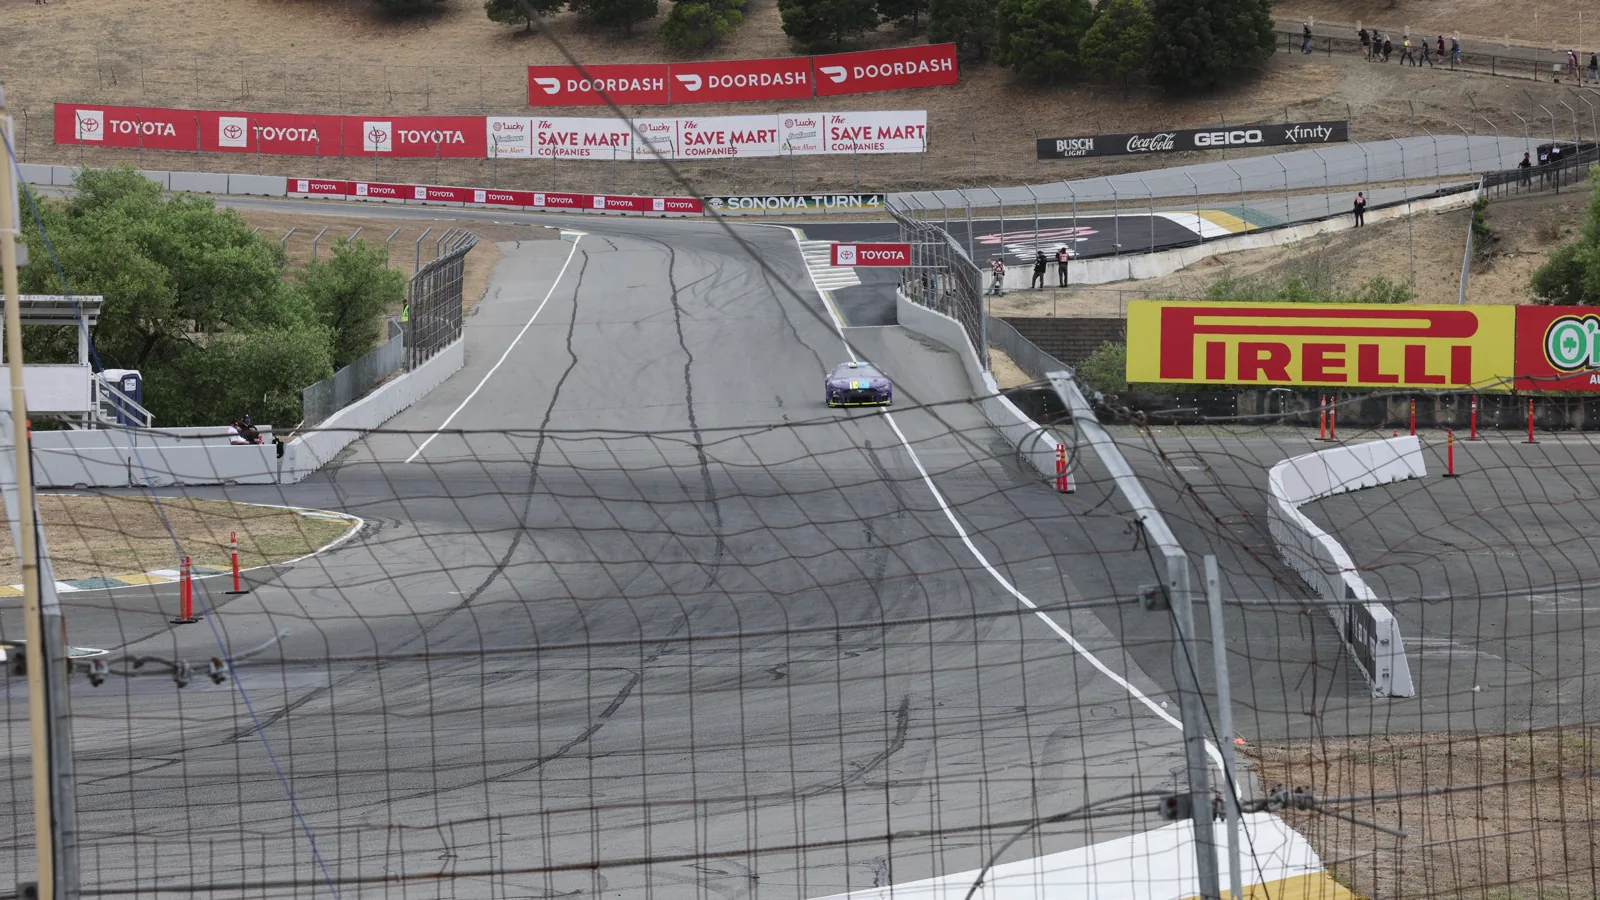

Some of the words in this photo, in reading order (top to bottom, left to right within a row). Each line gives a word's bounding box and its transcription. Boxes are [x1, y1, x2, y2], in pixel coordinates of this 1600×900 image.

[854, 58, 952, 79] DOORDASH
[567, 78, 664, 92] DOORDASH
[708, 72, 806, 88] DOORDASH
[538, 120, 552, 129] The
[684, 120, 698, 129] The
[794, 118, 816, 128] Lucky
[830, 115, 846, 124] The
[110, 120, 176, 136] TOYOTA
[253, 126, 320, 142] TOYOTA
[503, 122, 524, 132] Lucky
[831, 126, 872, 140] SAVE
[877, 125, 924, 140] MART
[1285, 125, 1332, 142] xfinity
[398, 130, 465, 144] TOYOTA
[538, 132, 578, 146] SAVE
[584, 132, 630, 146] MART
[684, 131, 725, 146] SAVE
[730, 129, 776, 144] MART
[1126, 133, 1176, 152] Coca-Cola
[1194, 130, 1262, 146] GEICO
[538, 148, 590, 156] COMPANIES
[685, 147, 738, 156] COMPANIES
[832, 143, 885, 151] COMPANIES
[1056, 138, 1094, 152] BUSCH
[728, 196, 808, 210] SONOMA
[811, 195, 862, 208] TURN
[866, 195, 879, 206] 4
[860, 250, 905, 260] TOYOTA
[1160, 306, 1478, 384] PIRELLI
